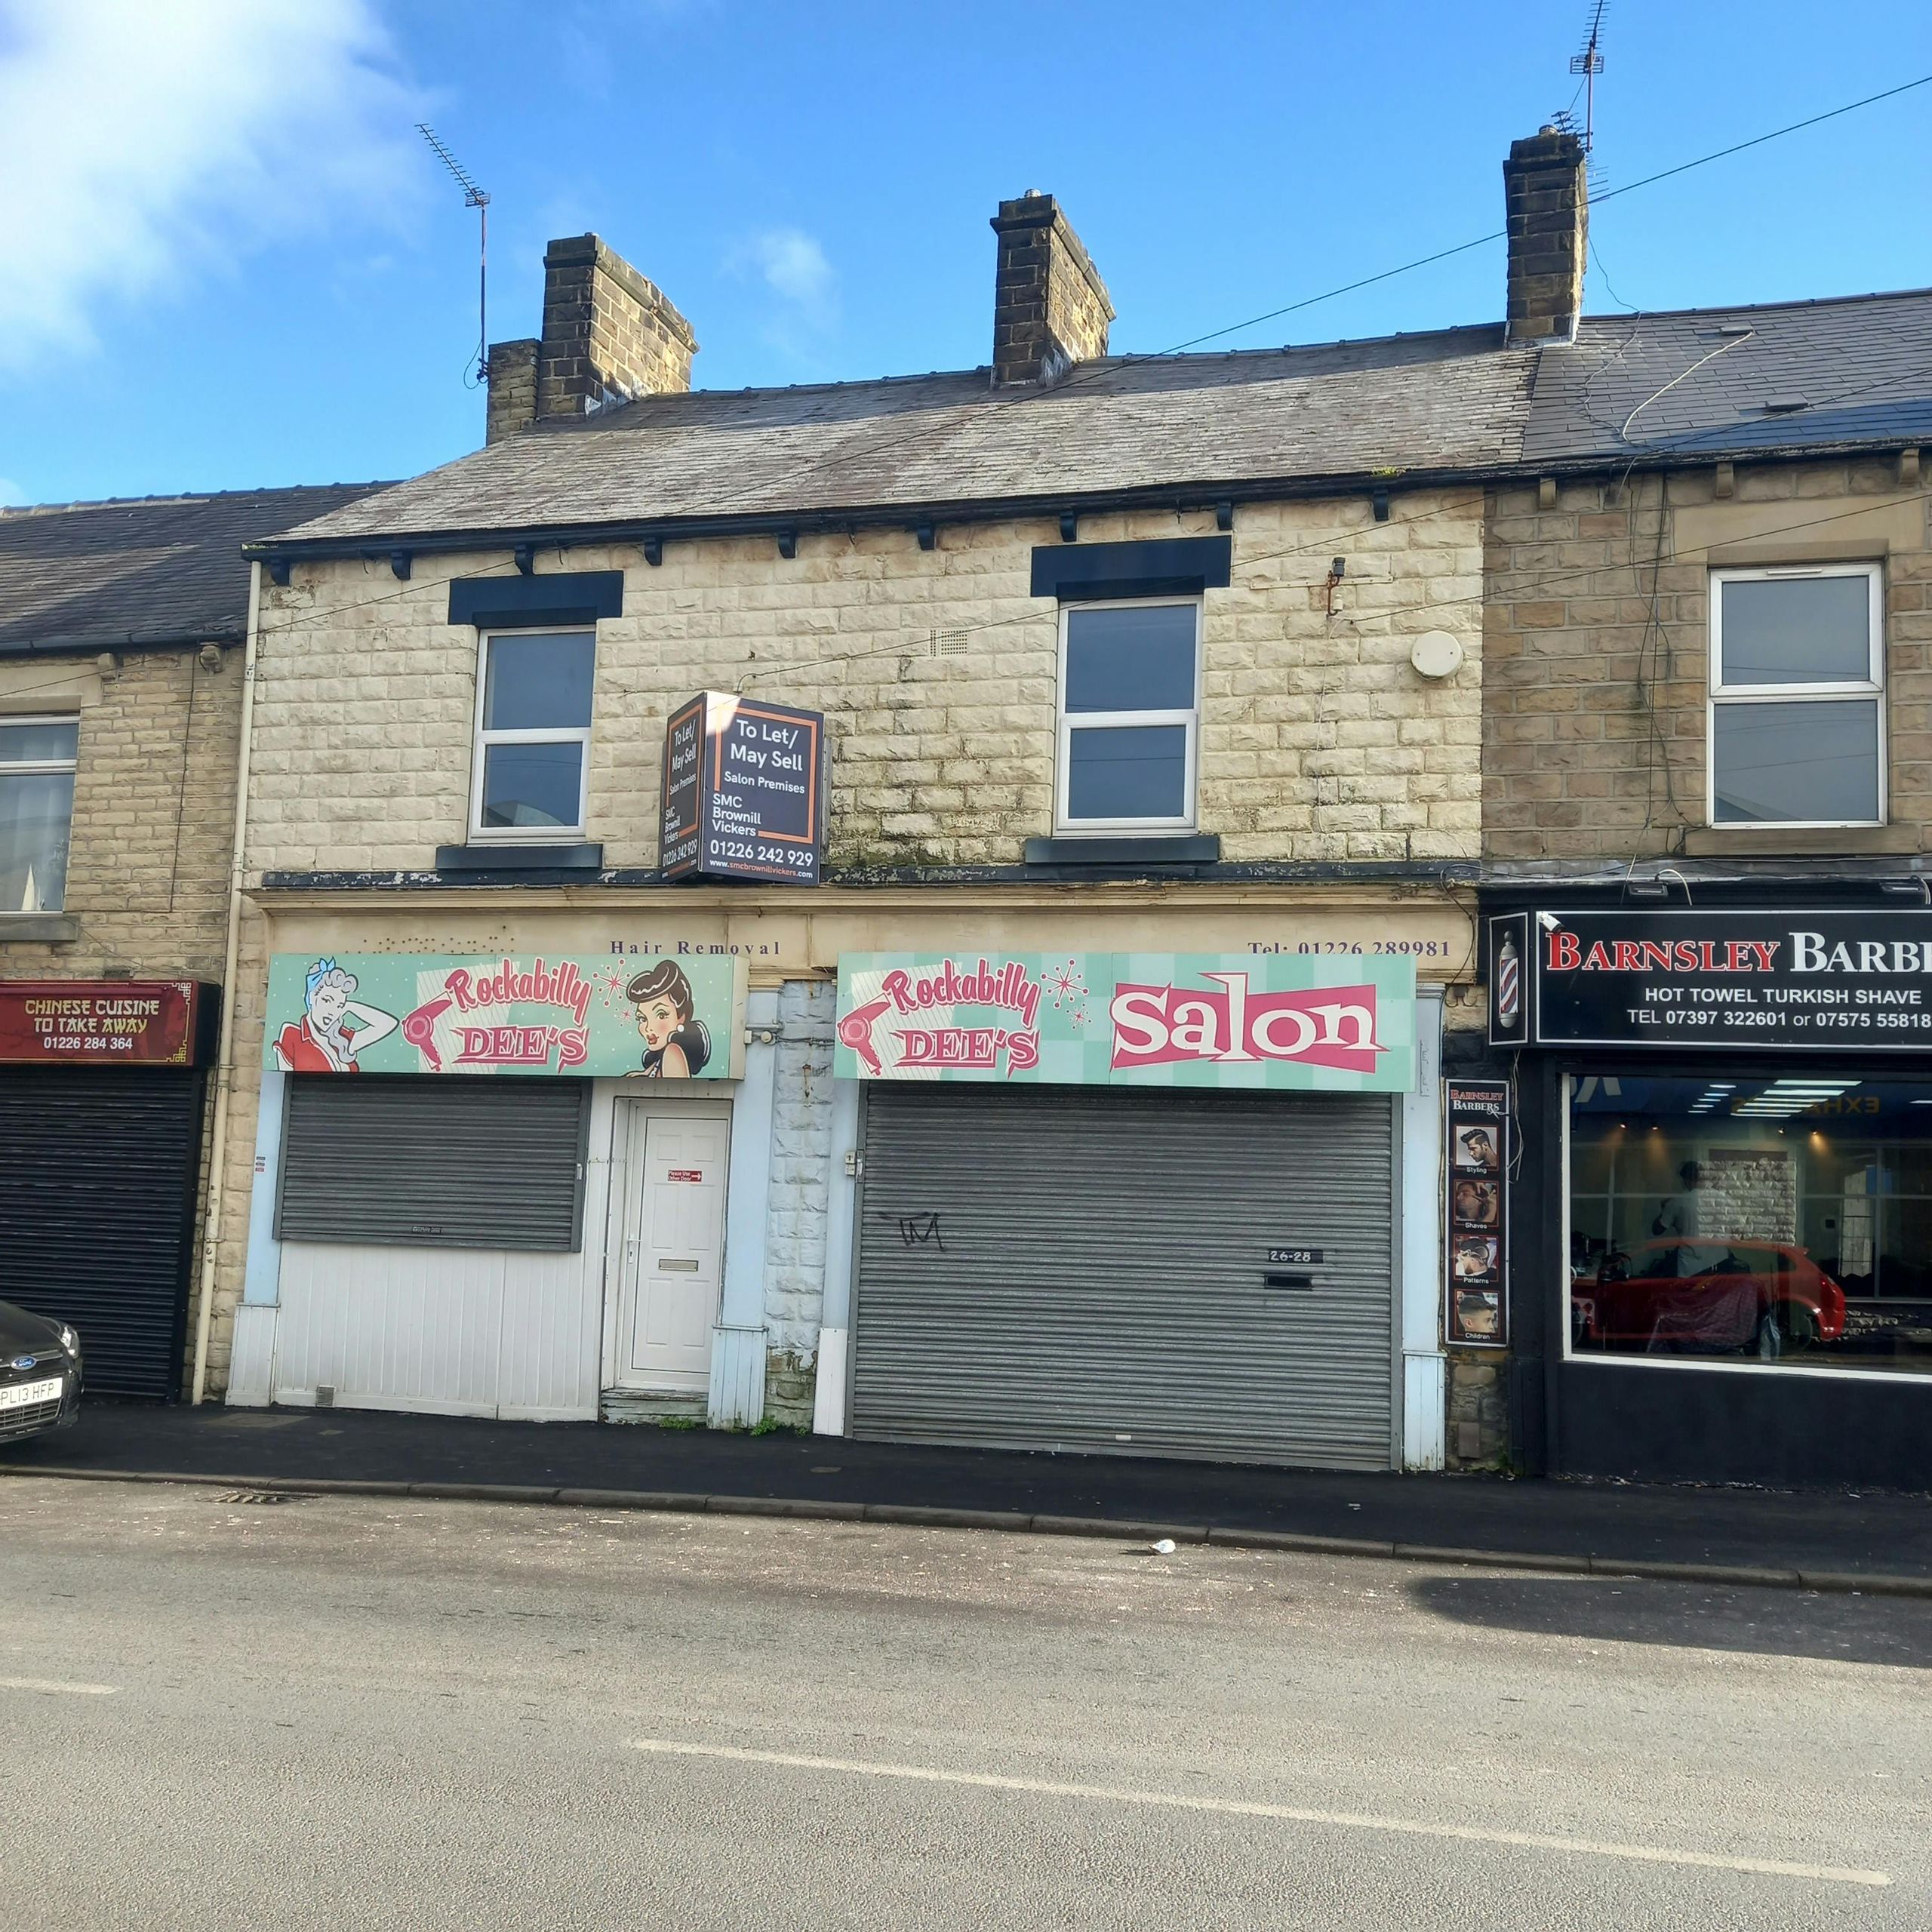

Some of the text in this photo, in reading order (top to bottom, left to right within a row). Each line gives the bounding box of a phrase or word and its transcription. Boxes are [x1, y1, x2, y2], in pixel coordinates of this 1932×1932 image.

[674, 718, 696, 747] To Let/
[737, 719, 798, 749] To Let/
[672, 743, 697, 773] May Sell
[731, 743, 803, 771] May Sell
[724, 771, 805, 794] Salon Premises
[712, 793, 743, 808] SMC
[712, 806, 761, 824] Brownill
[712, 819, 757, 837] Vickers
[710, 839, 814, 867] 01226 242 929
[709, 859, 814, 879] www.smcbrownillvickers.com
[611, 941, 780, 955] Hair Removal
[1371, 940, 1450, 957] 289981
[1545, 931, 1782, 973] BARNSLEY
[445, 958, 592, 1025] Rockabilly
[881, 958, 1041, 1030] Rockabilly
[1645, 987, 1922, 1004] HOT TOWEL TURKISH SHAVE
[25, 999, 160, 1016] CHINESE CUISINE
[34, 1017, 148, 1035] TO TAKE AWAY
[1110, 972, 1392, 1072] Salon
[1627, 1009, 1662, 1024] TEL
[1666, 1011, 1718, 1025] 07397
[1724, 1011, 1786, 1026] 322601
[1793, 1015, 1811, 1026] or
[1816, 1012, 1871, 1027] 07575
[44, 1036, 134, 1050] 01226 284 364
[448, 1024, 592, 1074] DEE'S
[888, 1027, 1041, 1079] DEE'S
[1450, 1089, 1504, 1101] BARNSLEY
[1453, 1100, 1500, 1112] BARBERS
[1466, 1166, 1487, 1174] Styling
[1270, 1251, 1311, 1262] 26-28
[1463, 1276, 1490, 1284] Patterns
[32, 1383, 54, 1400] HFP
